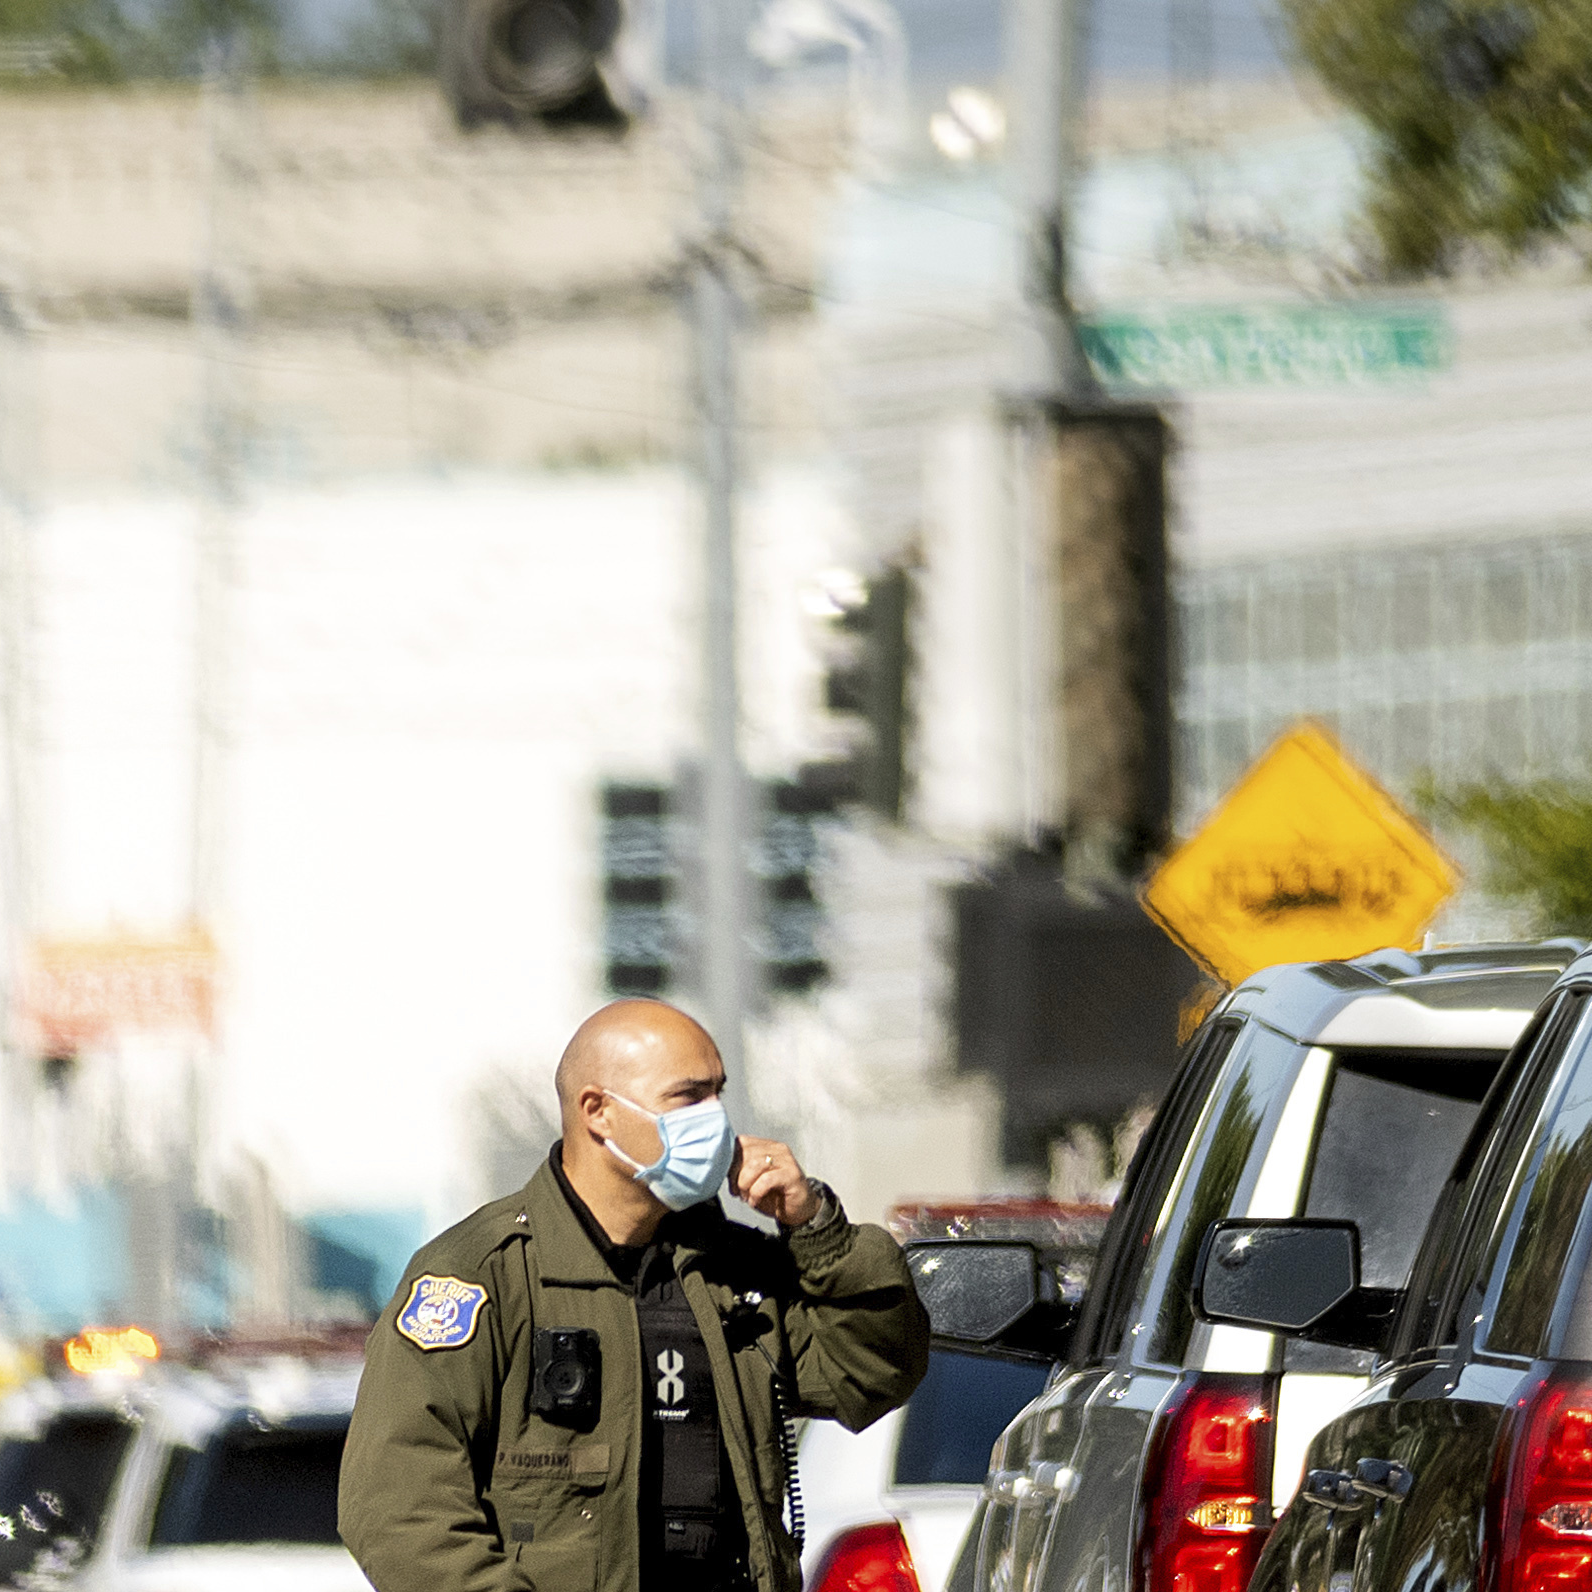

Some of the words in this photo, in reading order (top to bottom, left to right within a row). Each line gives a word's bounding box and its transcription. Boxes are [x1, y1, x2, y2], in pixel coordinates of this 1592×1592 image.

[420, 1282, 476, 1304] SHERIFF
[405, 1315, 430, 1335] SANTA
[431, 1325, 463, 1338] CLARA
[409, 1328, 448, 1342] COUNTY
